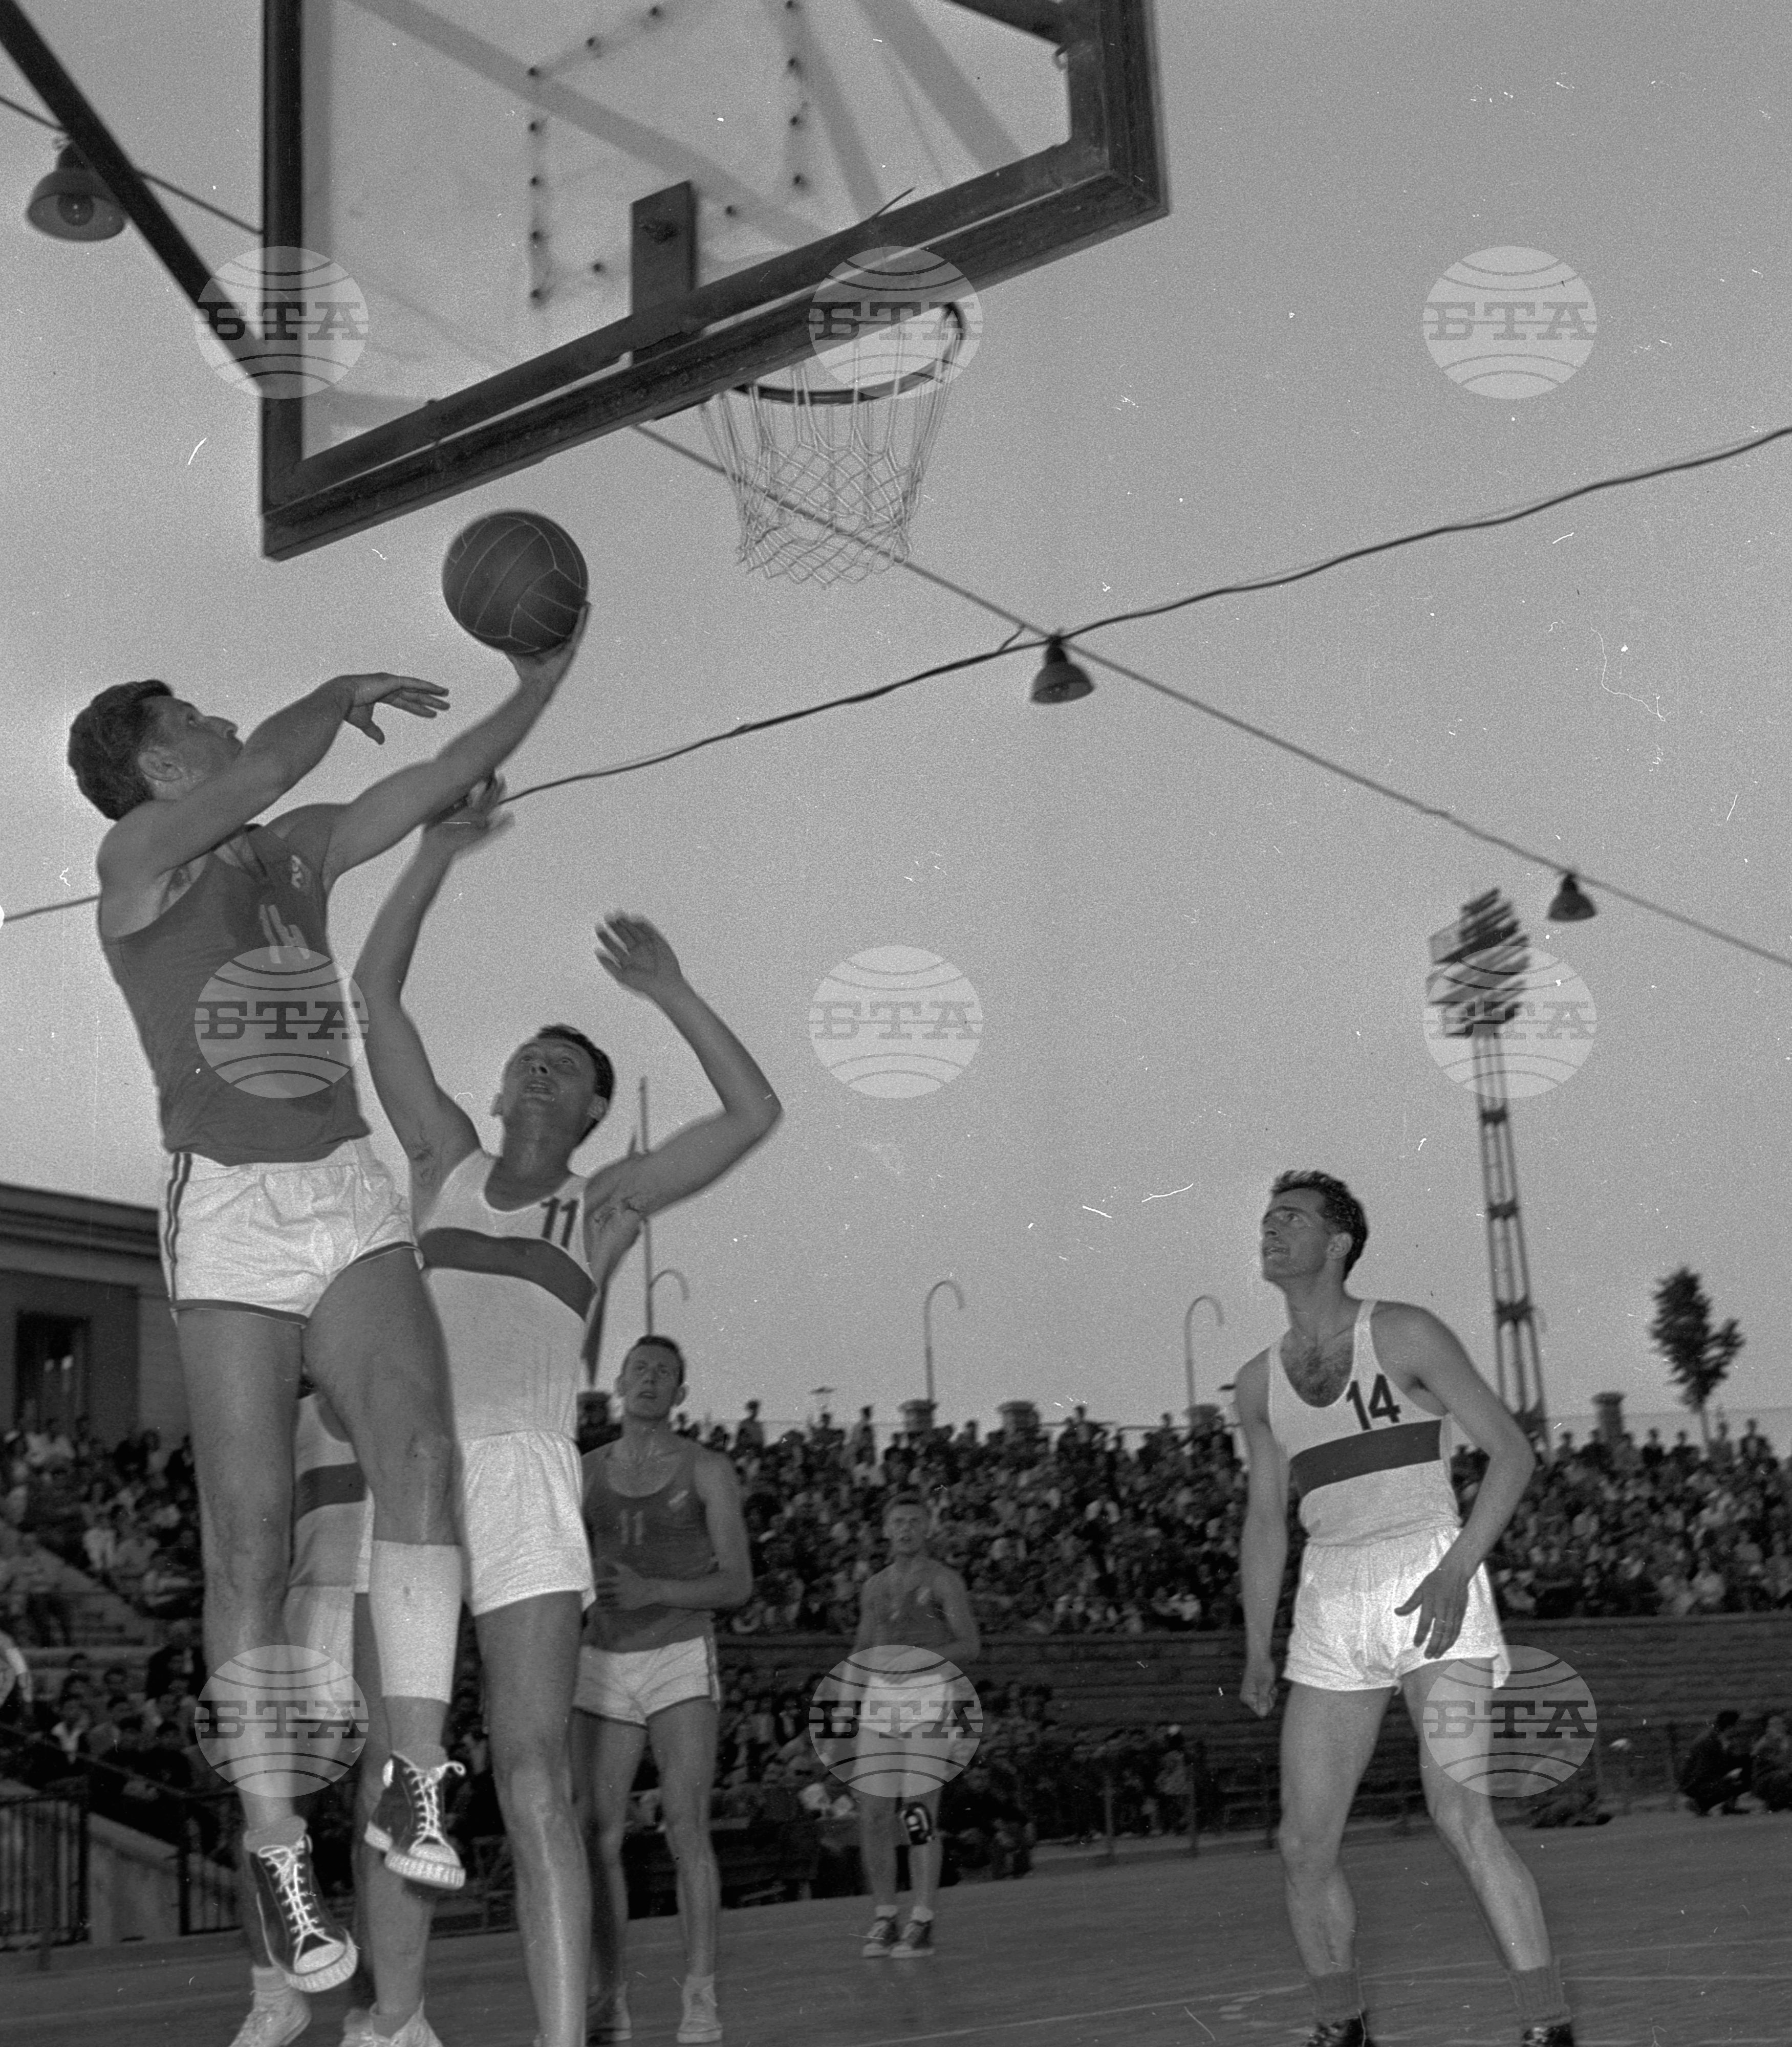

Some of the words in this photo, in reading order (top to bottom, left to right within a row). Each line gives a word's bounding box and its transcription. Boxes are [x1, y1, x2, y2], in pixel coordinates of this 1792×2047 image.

[540, 1197, 579, 1249] 11
[1346, 1373, 1401, 1431] 14
[618, 1510, 643, 1545] 11
